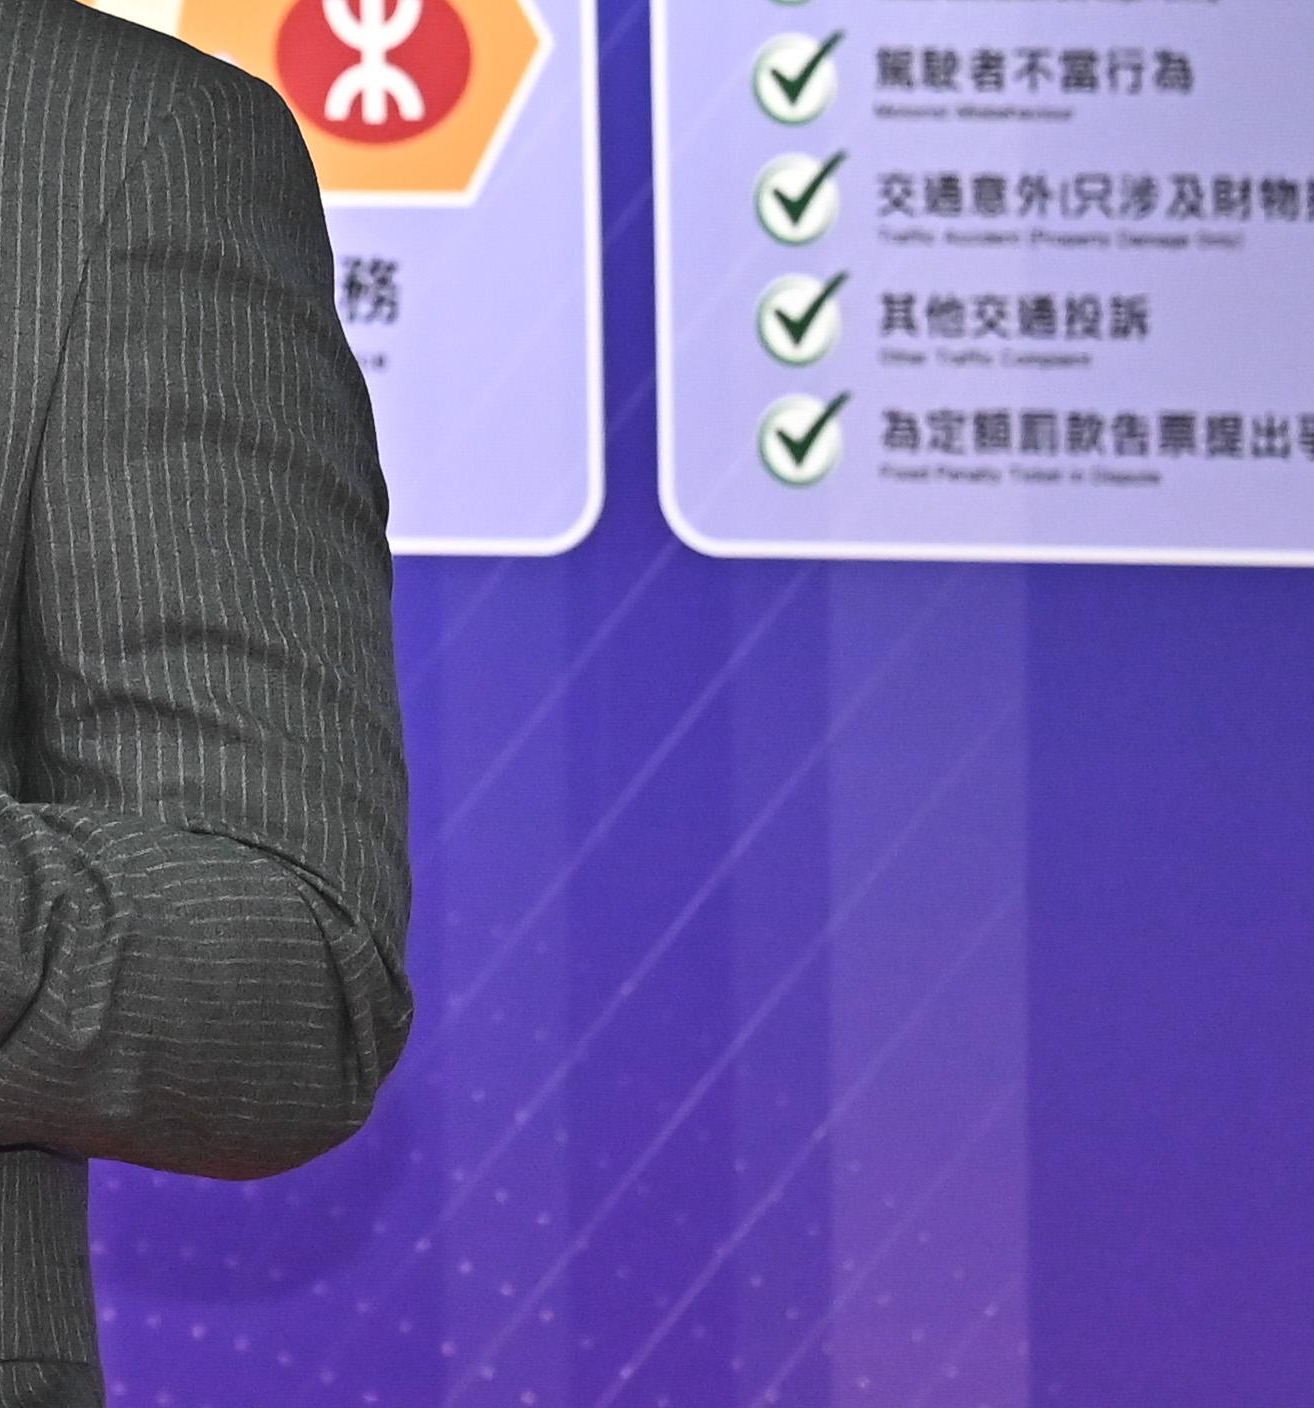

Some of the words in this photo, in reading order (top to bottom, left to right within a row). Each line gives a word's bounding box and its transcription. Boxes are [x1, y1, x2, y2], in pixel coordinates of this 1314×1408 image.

[876, 47, 1194, 93] 駕駛者不當行為
[878, 173, 1314, 221] 交通意外(只涉及財物
[341, 256, 399, 325] 務
[881, 294, 1149, 340] 其他交通投訴
